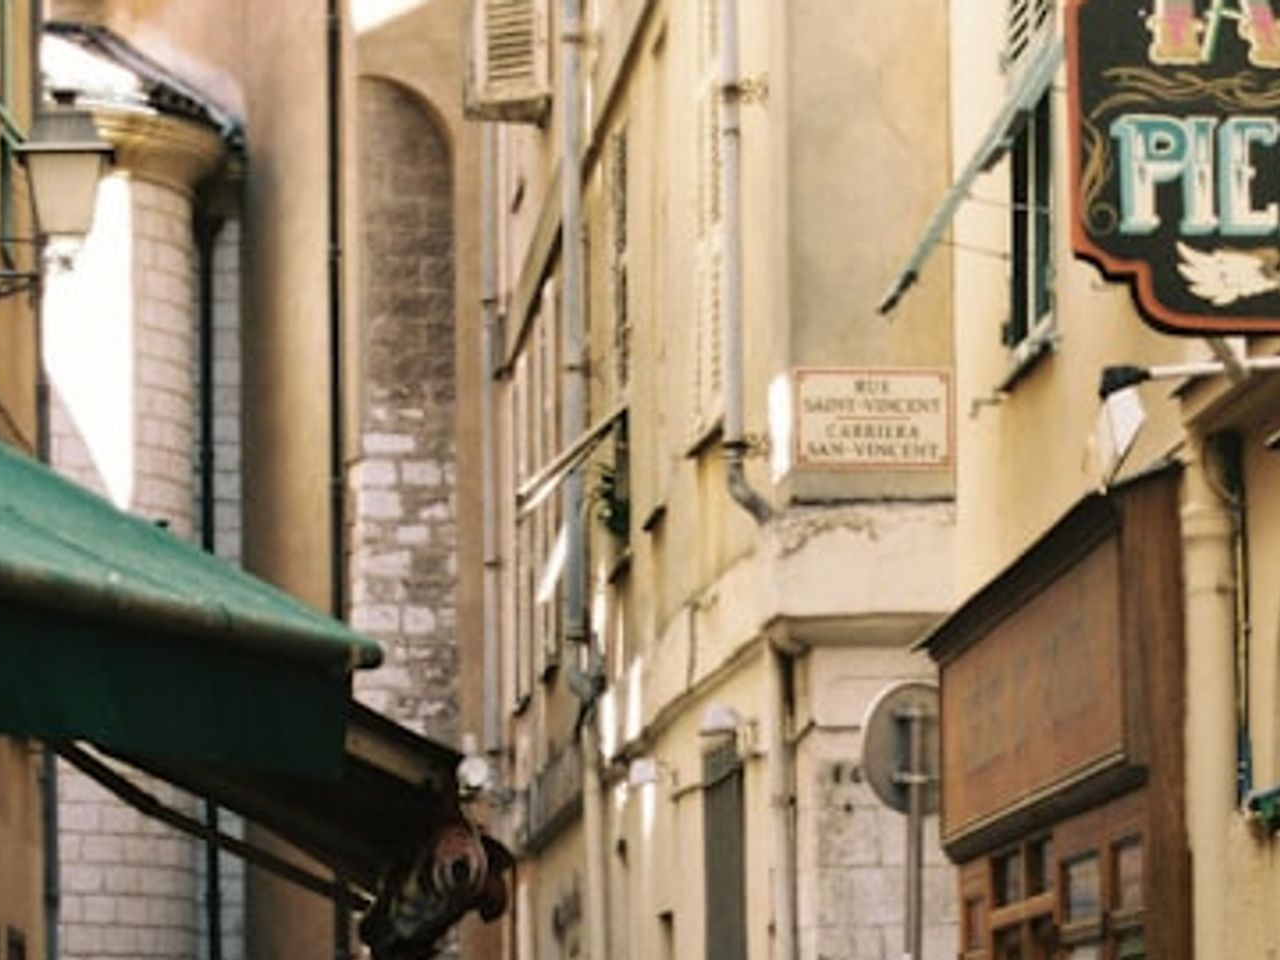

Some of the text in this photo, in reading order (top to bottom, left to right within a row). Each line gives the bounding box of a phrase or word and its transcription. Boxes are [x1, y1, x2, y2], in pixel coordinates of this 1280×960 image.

[854, 380, 890, 393] RUE
[804, 398, 940, 413] SAINT-VINCENT
[825, 423, 919, 438] CARRIERA
[807, 441, 939, 458] SAN-VINCENT
